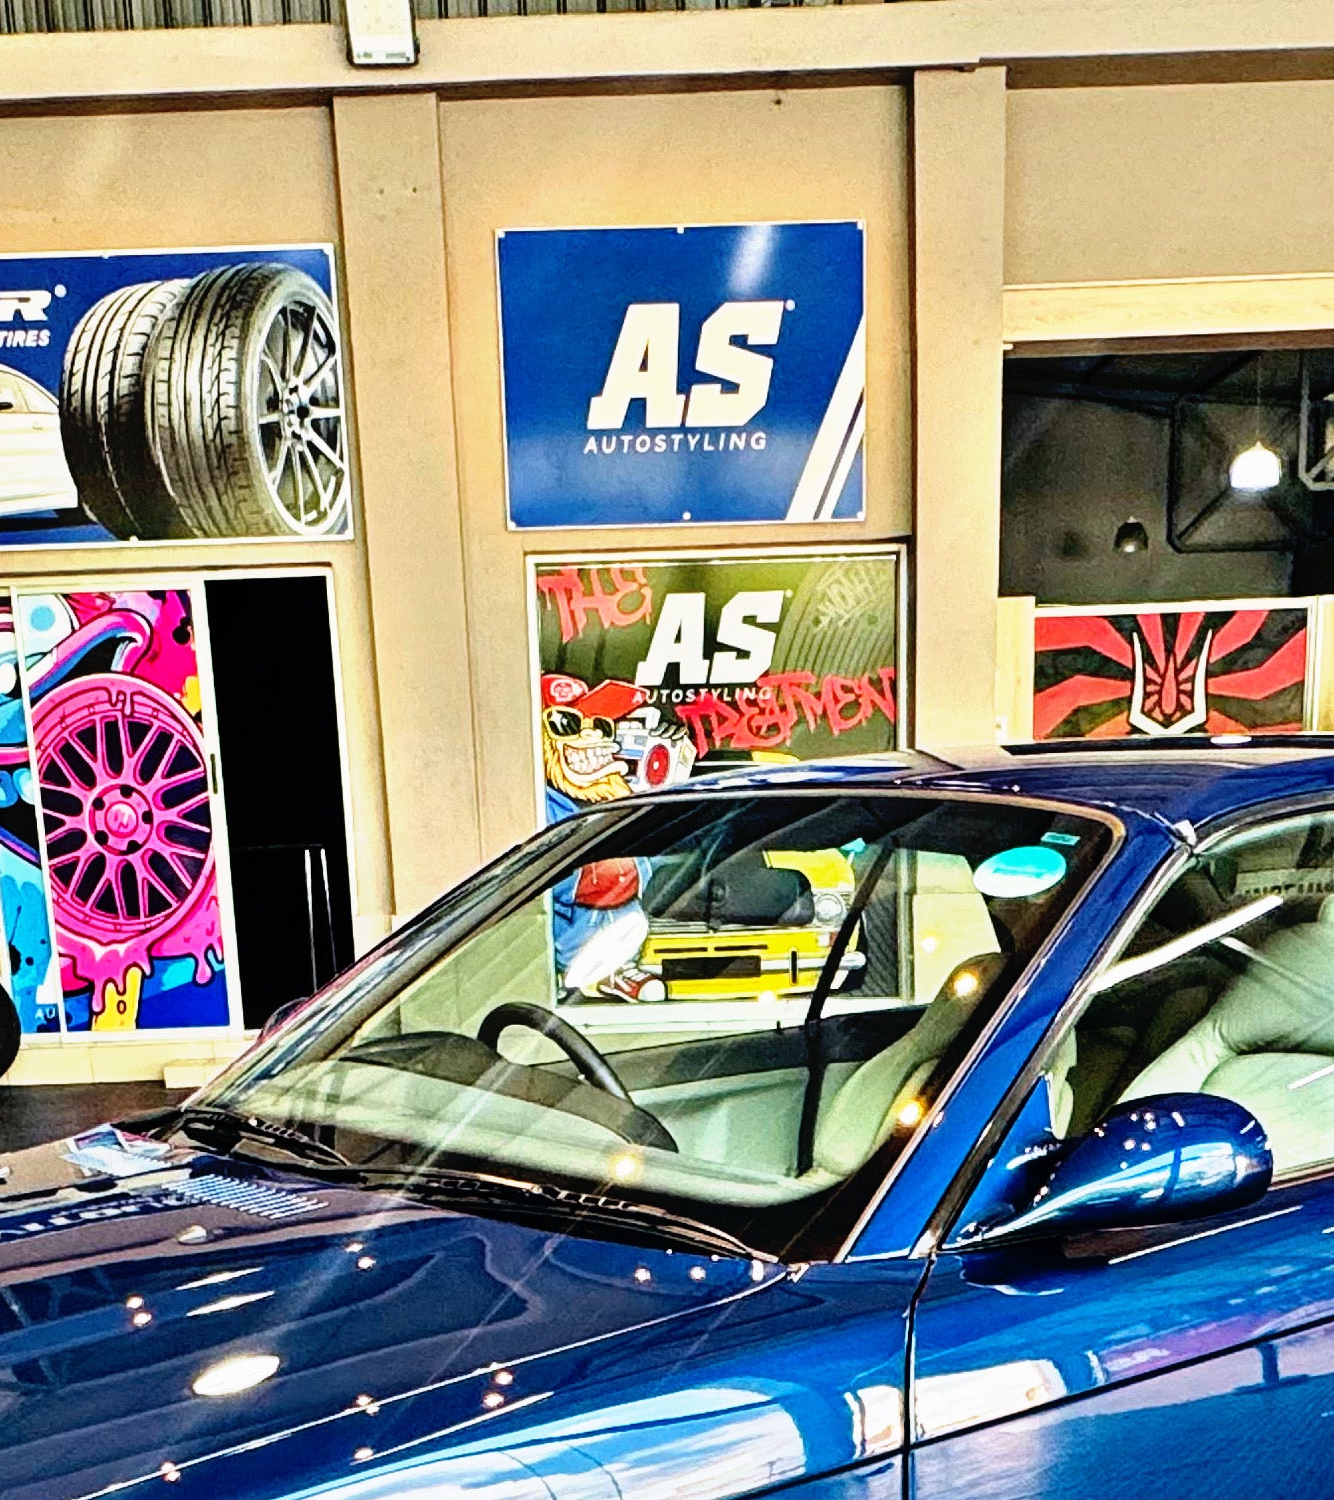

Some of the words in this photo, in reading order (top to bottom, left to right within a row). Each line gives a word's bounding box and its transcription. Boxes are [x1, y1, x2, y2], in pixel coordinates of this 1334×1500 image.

[587, 299, 785, 429] AS
[583, 431, 768, 455] AUTOSTYLING
[537, 566, 654, 644] THE
[635, 589, 785, 686] AS
[631, 685, 774, 705] AUTOSTYLING
